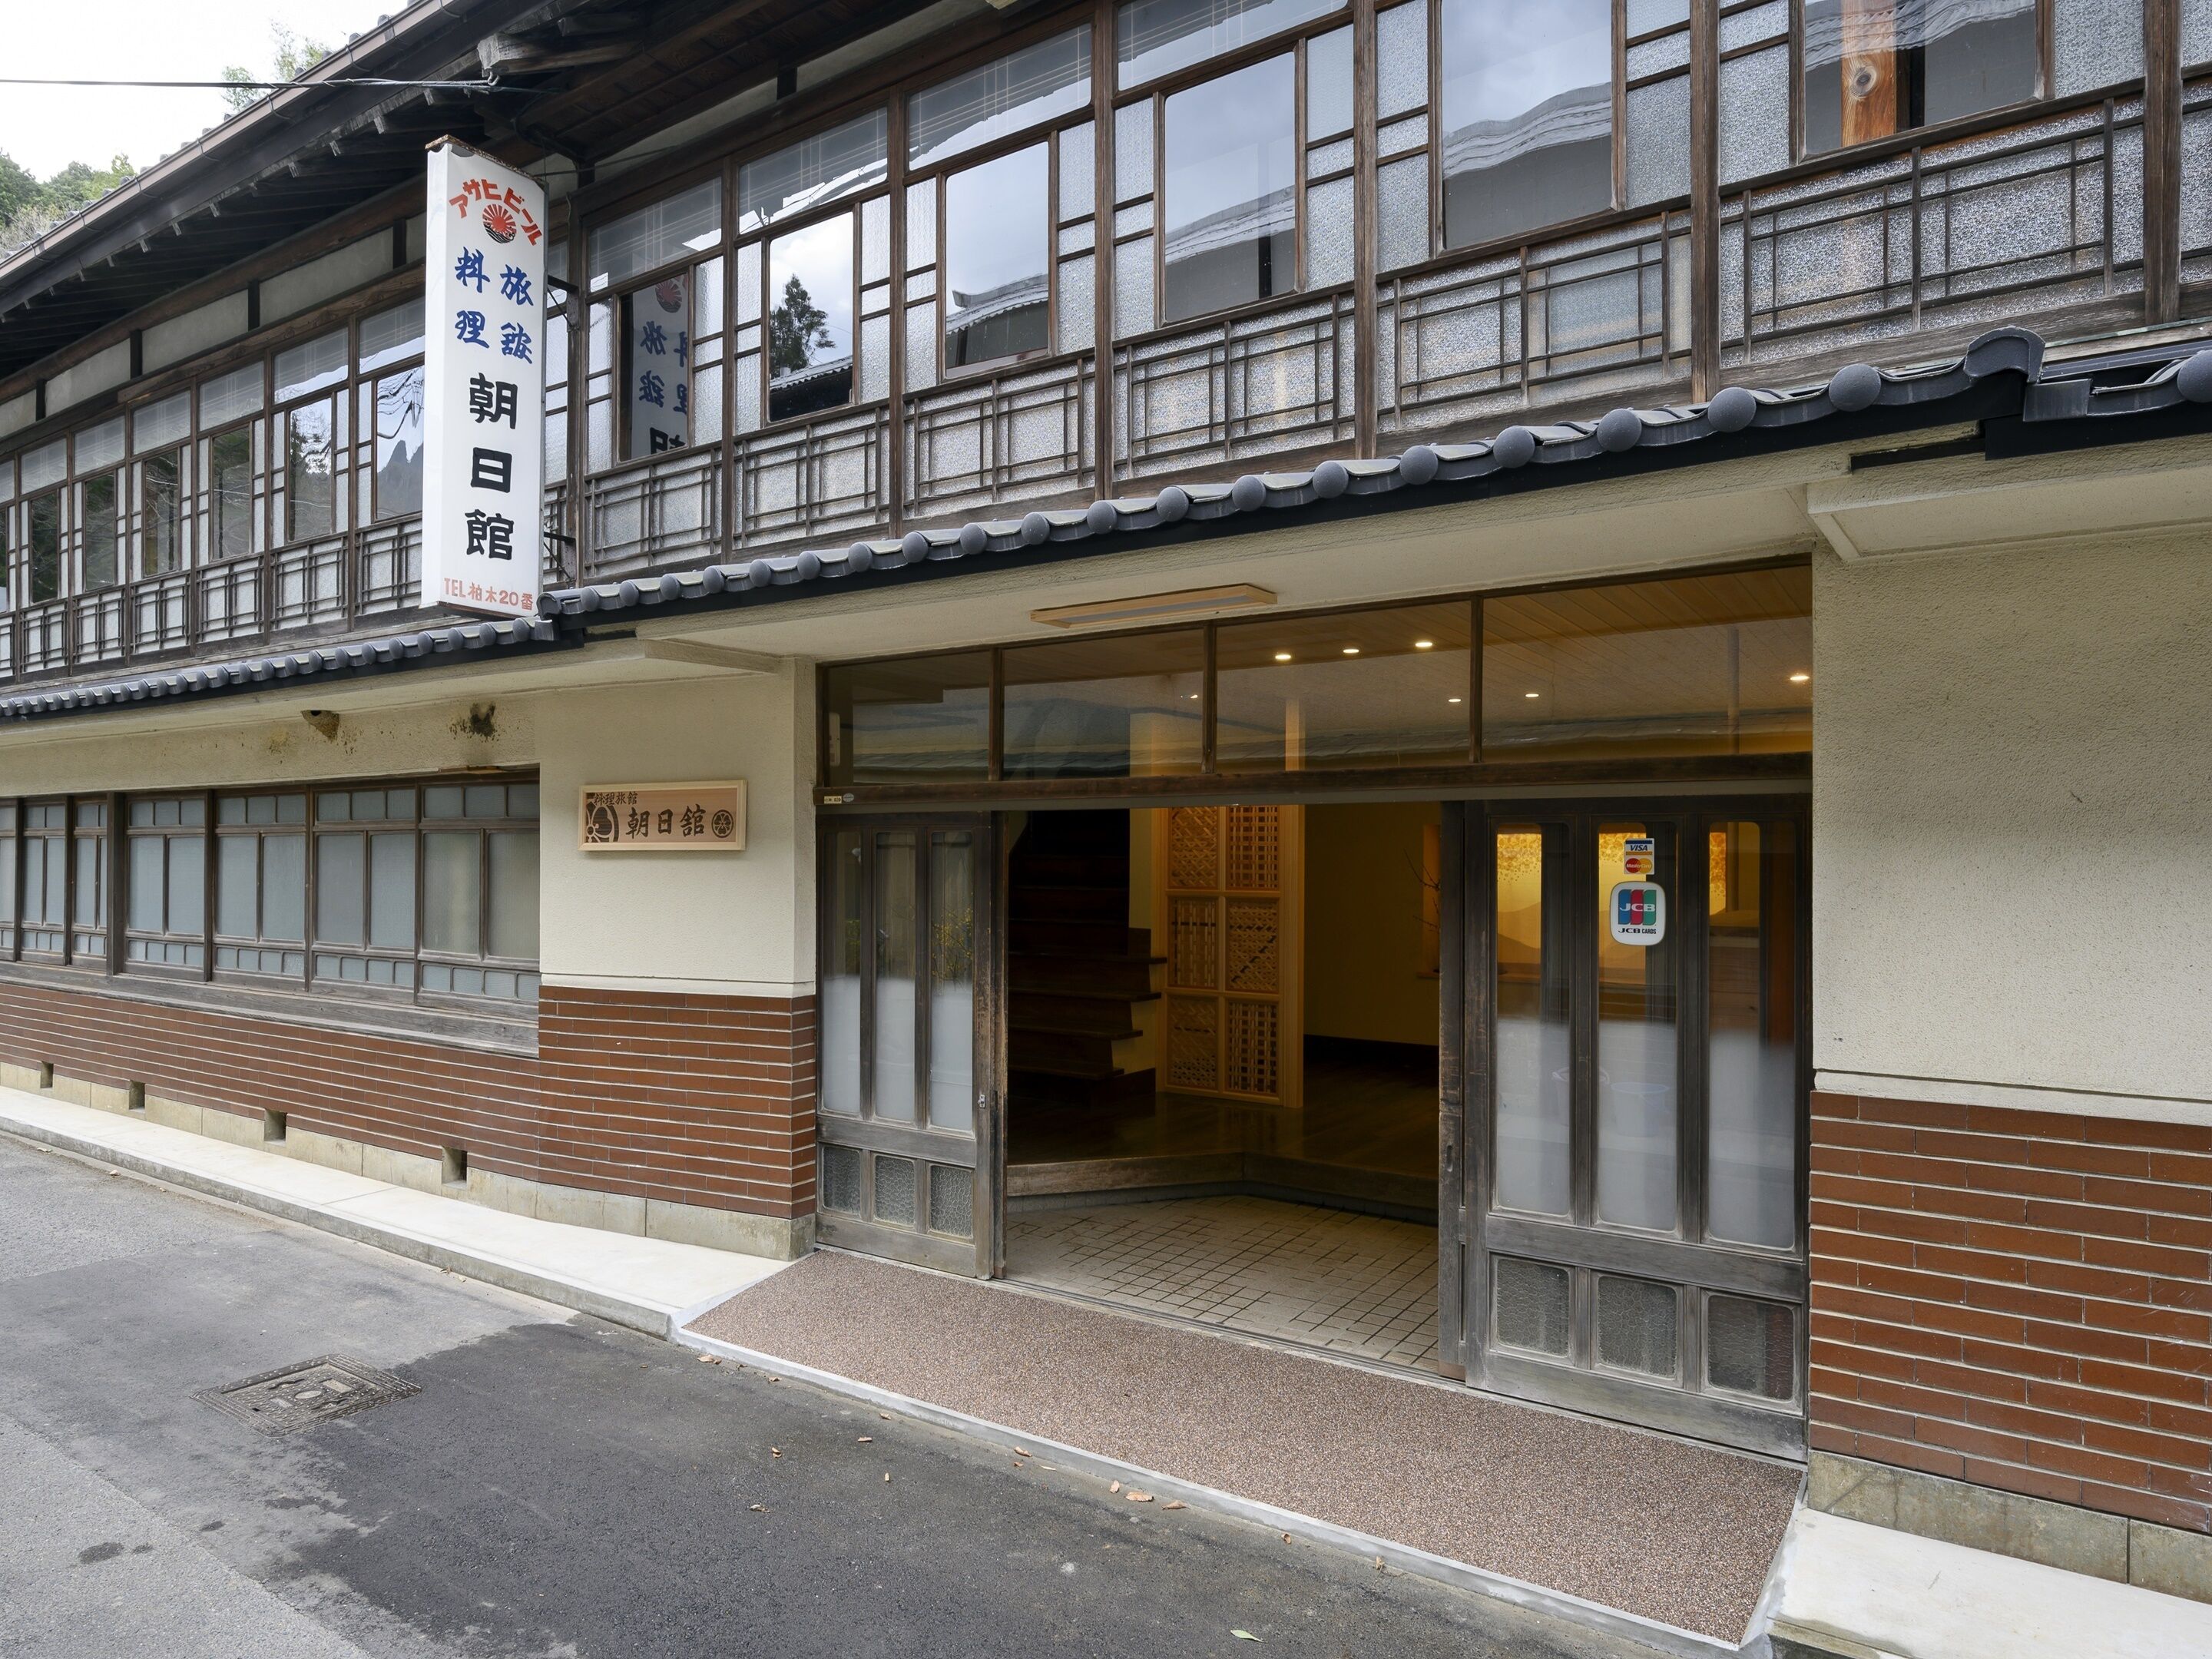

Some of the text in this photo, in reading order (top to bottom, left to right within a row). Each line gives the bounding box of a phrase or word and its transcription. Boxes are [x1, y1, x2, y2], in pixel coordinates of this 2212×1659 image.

[449, 178, 542, 246] アサヒビール
[454, 247, 490, 349] 料理
[465, 373, 518, 561] 朝日館
[1619, 903, 1656, 912] JCB
